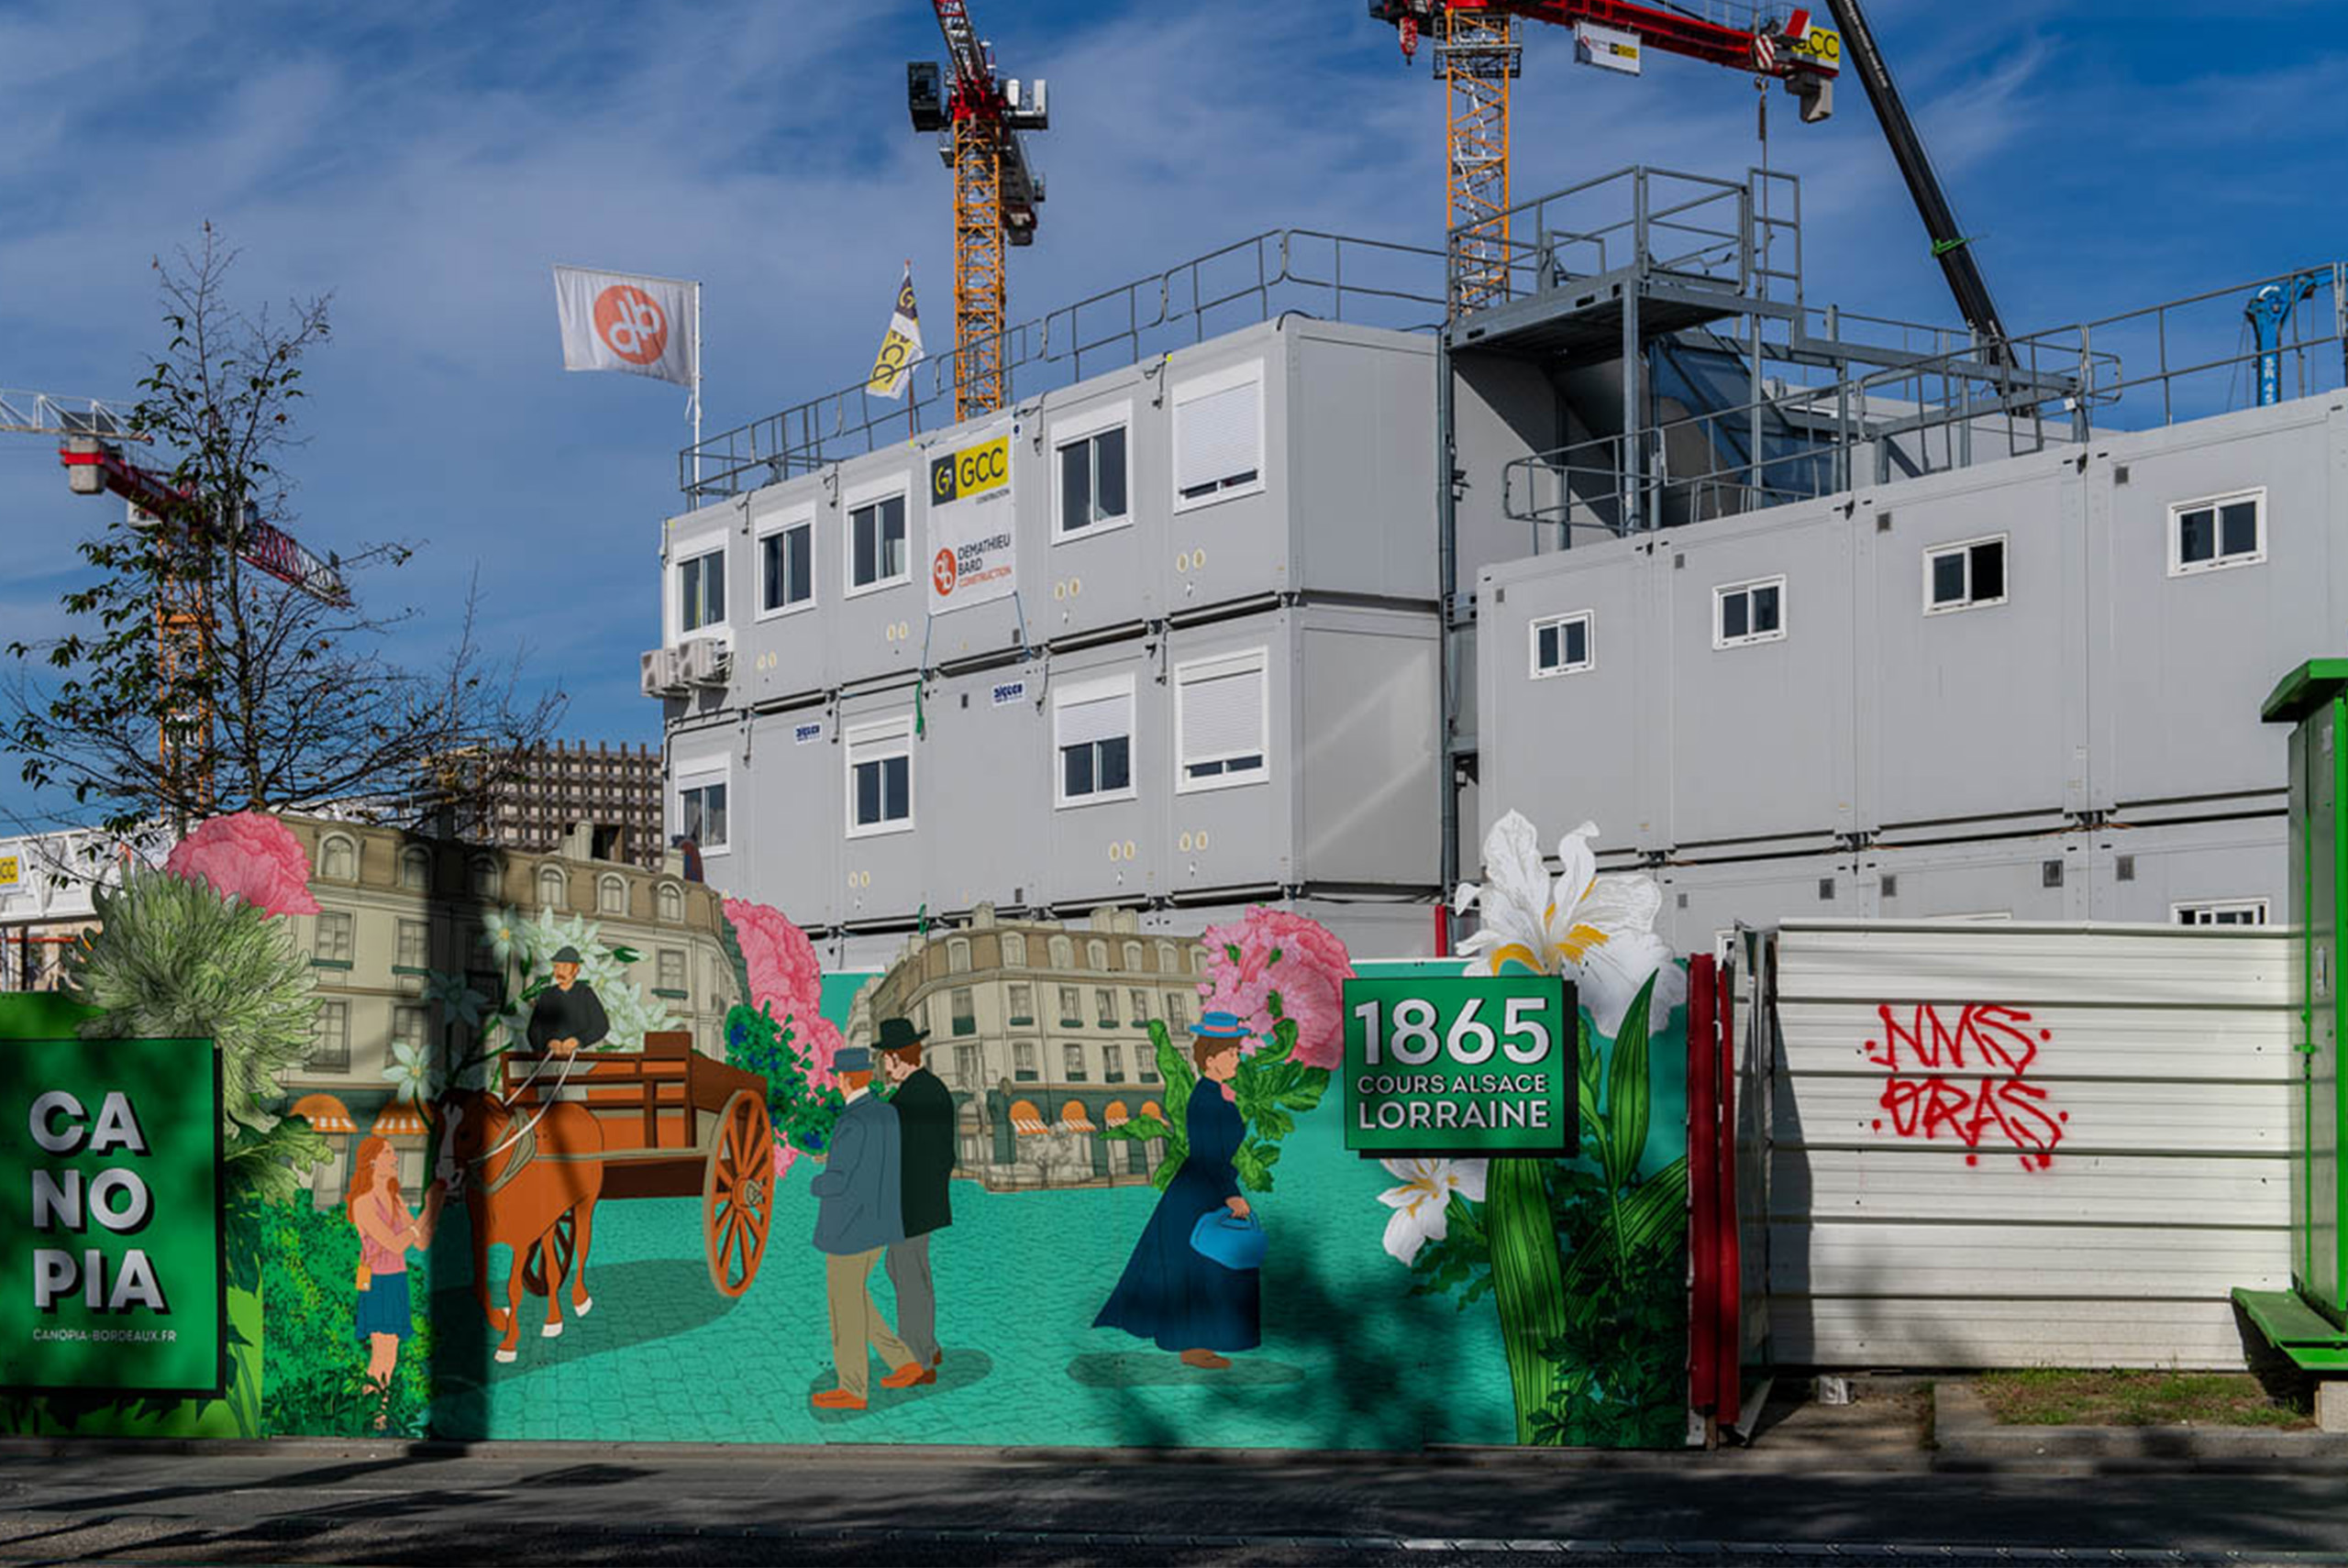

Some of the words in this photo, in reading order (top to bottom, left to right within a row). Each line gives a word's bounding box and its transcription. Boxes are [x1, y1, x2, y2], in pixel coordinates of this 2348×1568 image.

[959, 446, 1005, 489] GCC
[957, 532, 1011, 561] DEMATHIEU
[957, 557, 984, 577] BARD
[1354, 997, 1551, 1066] 1865
[1357, 1074, 1446, 1095] COURS
[1451, 1073, 1548, 1094] ALSACE
[28, 1089, 147, 1153] CA
[1358, 1099, 1550, 1130] LORRAINE
[31, 1166, 150, 1231] NO
[32, 1248, 166, 1309] PIA
[32, 1328, 177, 1342] CANOPIA-BORDEAUX.FR
